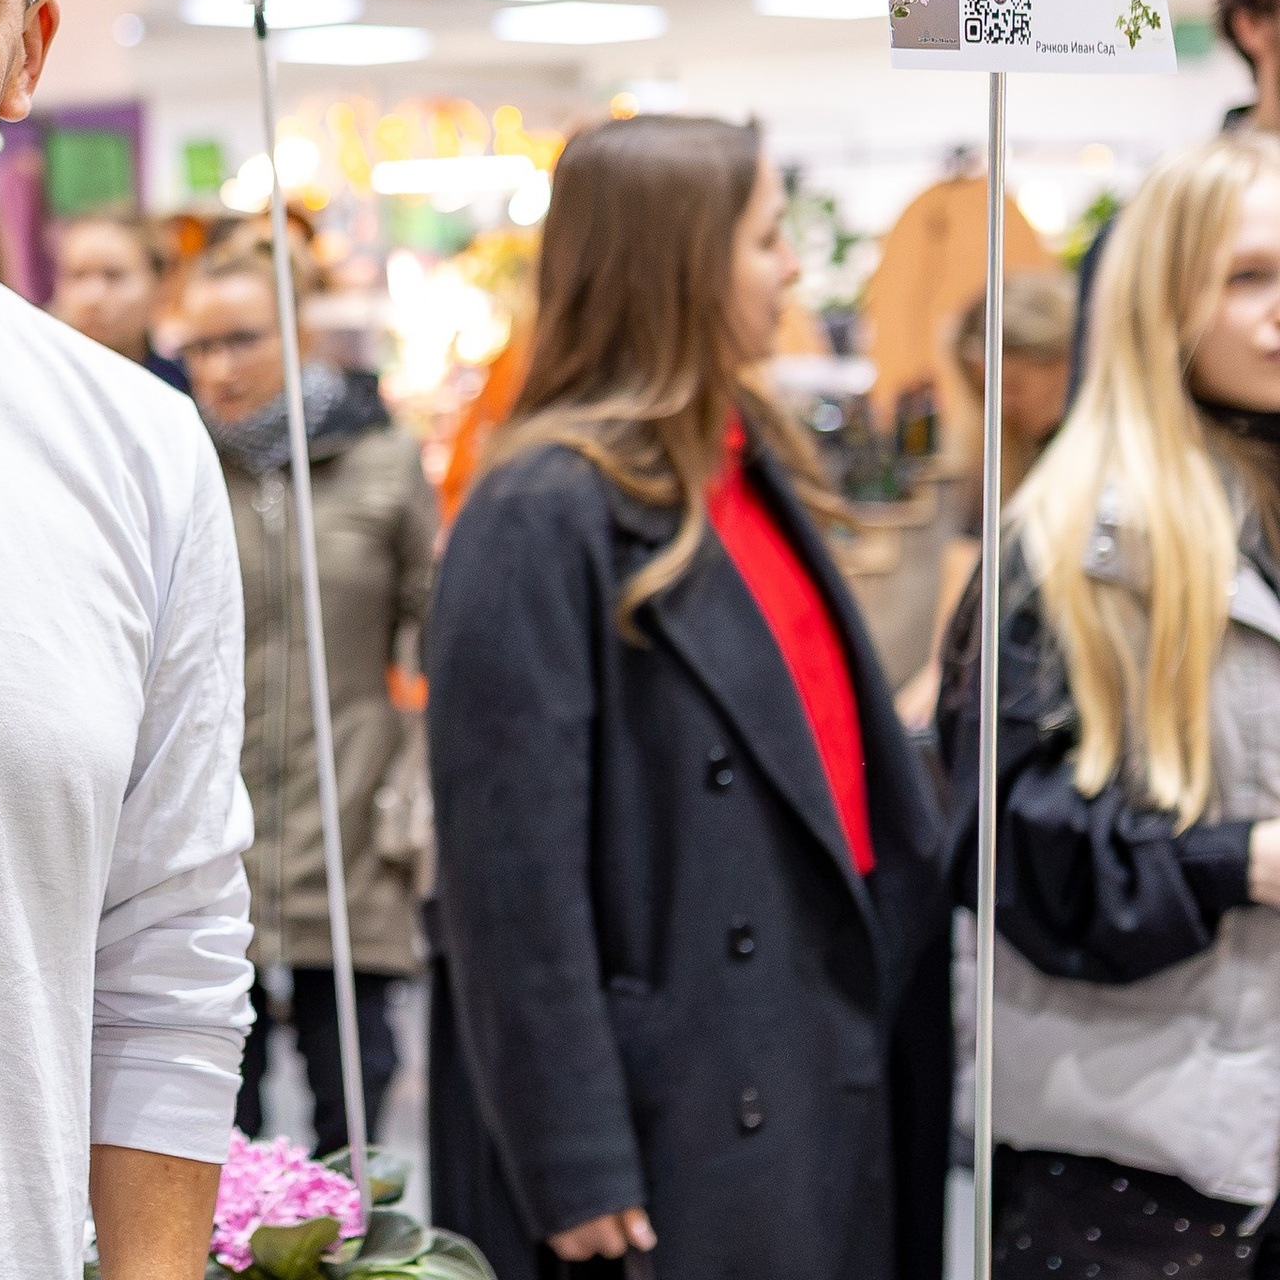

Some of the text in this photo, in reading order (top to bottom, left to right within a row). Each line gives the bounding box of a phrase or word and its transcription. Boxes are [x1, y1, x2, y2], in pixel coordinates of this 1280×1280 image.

[1035, 40, 1116, 56] Рачков Иван Сад
